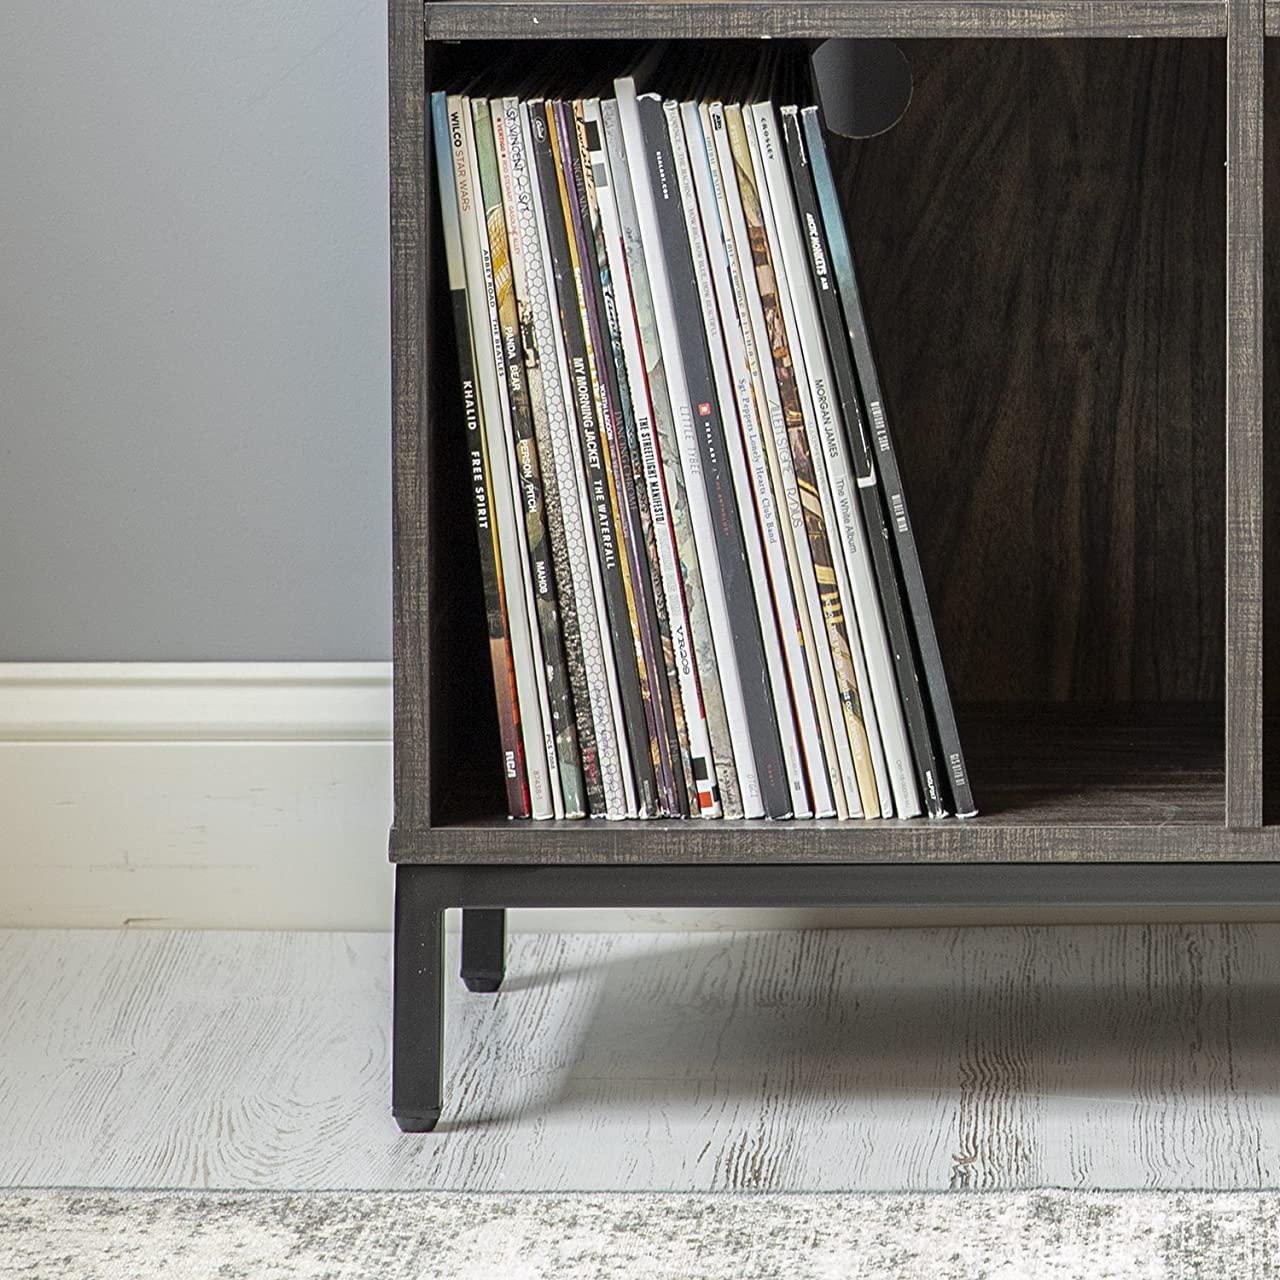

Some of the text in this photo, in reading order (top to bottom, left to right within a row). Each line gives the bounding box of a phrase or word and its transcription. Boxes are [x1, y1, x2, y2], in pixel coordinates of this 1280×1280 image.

[450, 111, 470, 212] WILCO STAR WARS
[496, 123, 505, 151] VERTIGO
[503, 174, 513, 202] STEWART
[507, 122, 523, 172] VINCENT
[677, 152, 686, 167] THE
[760, 116, 774, 160] CROSLEY
[655, 150, 669, 200] REALART.COM
[804, 212, 828, 290] ARCTIC MONKEYS AM
[482, 249, 495, 308] ABBEY ROAD
[491, 318, 505, 377] THE BEATLES
[503, 326, 520, 391] PANDA BEAR
[573, 356, 585, 374] MY
[462, 380, 476, 430] KHALID
[575, 375, 593, 428] MORNING
[598, 384, 613, 440] YOUTH LAGOON
[679, 405, 693, 441] LITTLE
[740, 396, 755, 432] Peppers
[813, 379, 831, 425] MORGAN
[823, 426, 838, 458] JAMES
[584, 427, 600, 471] JACKET
[613, 410, 637, 512] DANCING CHROME
[638, 417, 657, 480] THE STREETLIGHT
[703, 421, 717, 464] REAL ART
[747, 434, 761, 464] Lonely
[768, 398, 784, 436] ALLEN
[786, 486, 803, 528] RADIUS
[877, 435, 890, 452] SONS
[470, 450, 488, 530] FREE SPIRIT
[519, 439, 537, 513] PERSON PITCH
[755, 466, 767, 495] Hearts
[593, 479, 615, 570] THE WATERFALL
[761, 497, 772, 519] Club
[765, 521, 777, 544] Band
[835, 479, 858, 554] The White Album
[675, 625, 690, 675] VR209
[504, 750, 516, 778] RCA
